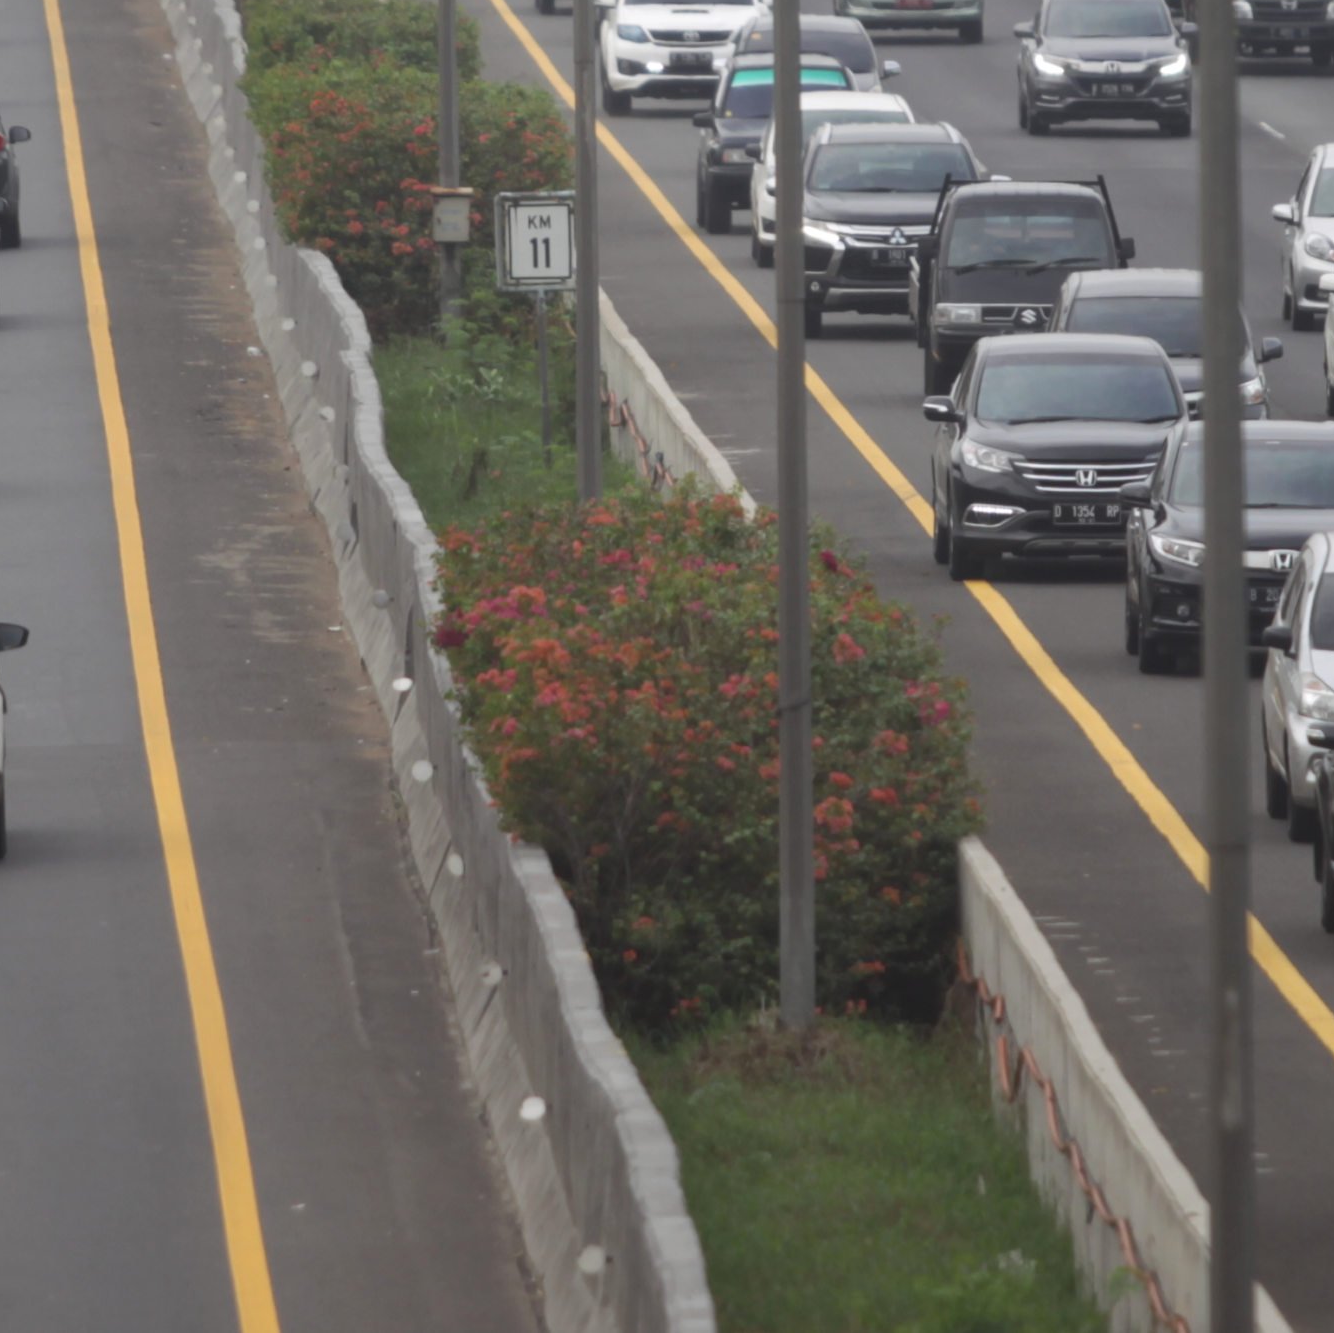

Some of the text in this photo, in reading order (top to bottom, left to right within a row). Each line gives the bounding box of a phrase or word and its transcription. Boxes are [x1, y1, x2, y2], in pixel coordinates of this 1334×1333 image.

[527, 215, 552, 230] KM
[530, 237, 551, 269] 11
[1072, 504, 1096, 517] 1354
[1106, 504, 1120, 517] RP
